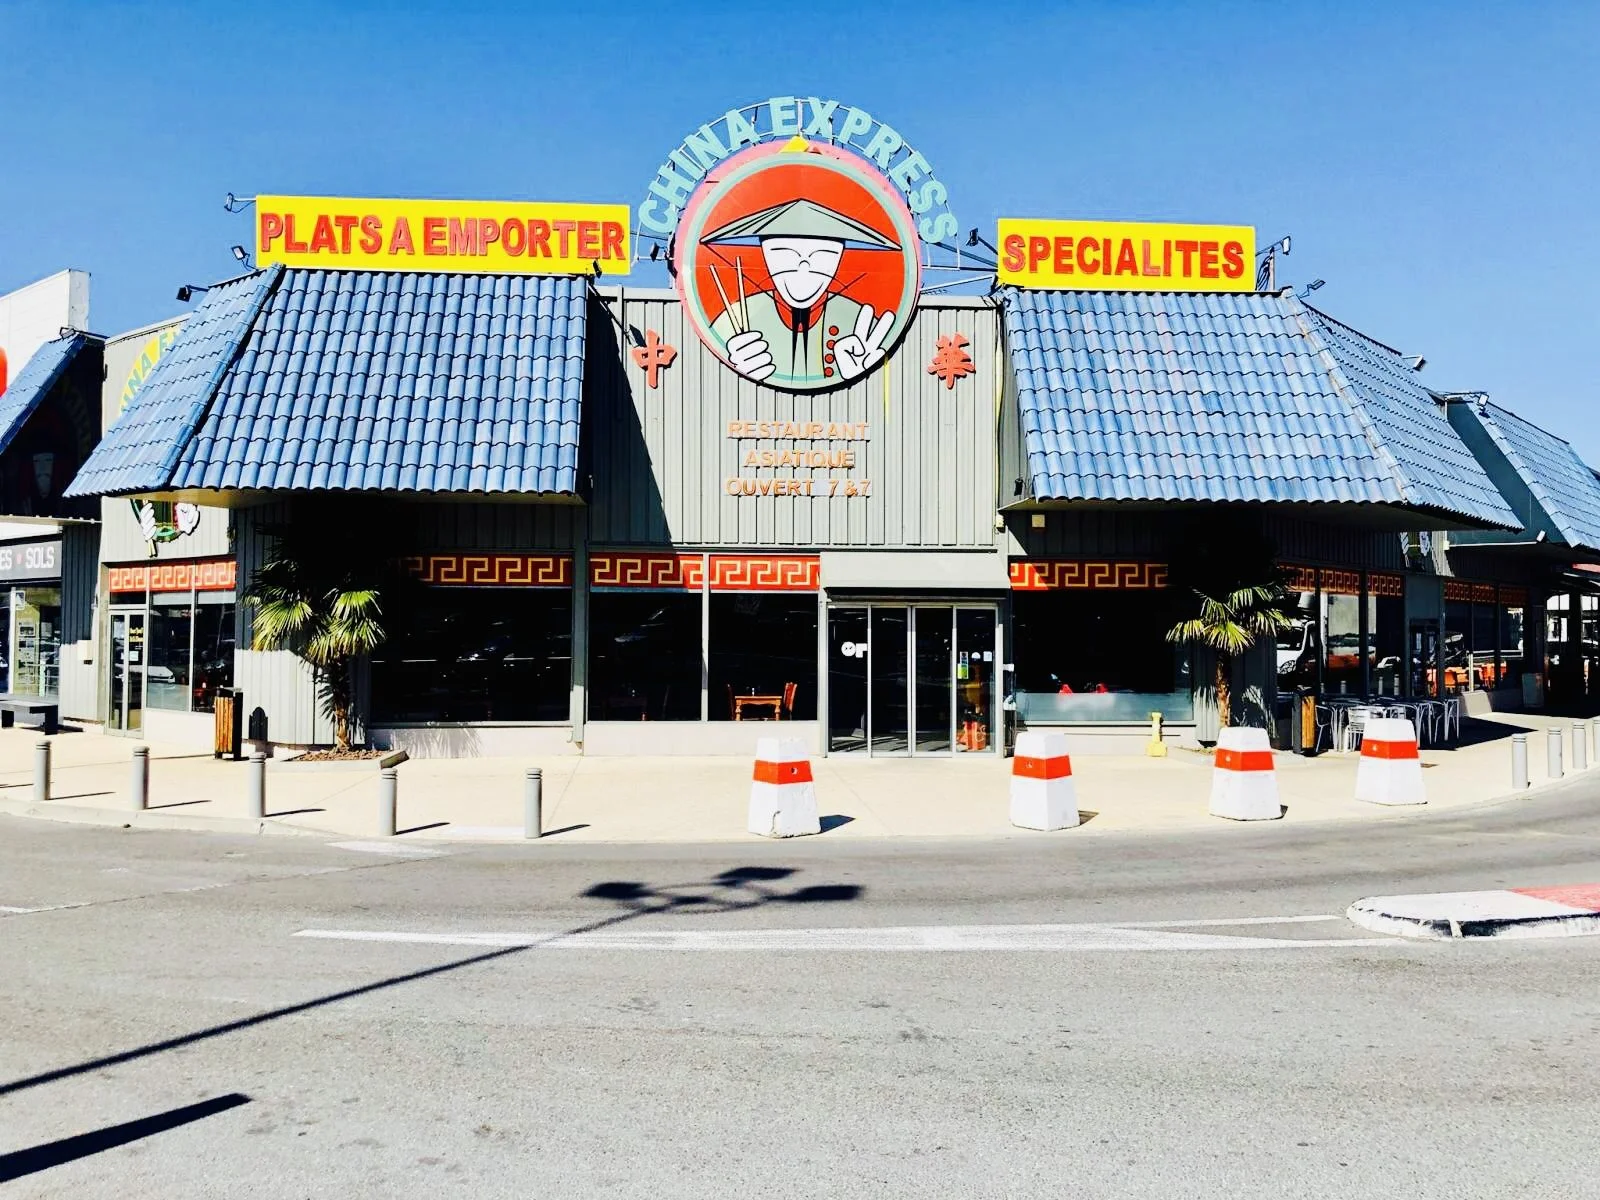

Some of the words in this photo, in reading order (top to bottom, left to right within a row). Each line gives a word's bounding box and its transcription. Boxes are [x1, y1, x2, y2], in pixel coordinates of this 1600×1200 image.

[638, 109, 761, 233] CHINA
[769, 96, 958, 243] EXPRESS
[260, 212, 382, 255] PLATS
[388, 216, 415, 255] A
[423, 217, 626, 260] EMPORTER
[1002, 234, 1245, 279] SPECIALITES
[631, 328, 677, 389] 中
[727, 420, 870, 440] RESTAURANT
[744, 450, 856, 468] ASIATIQUE
[726, 478, 815, 496] OUVERT
[25, 546, 55, 569] SOLS
